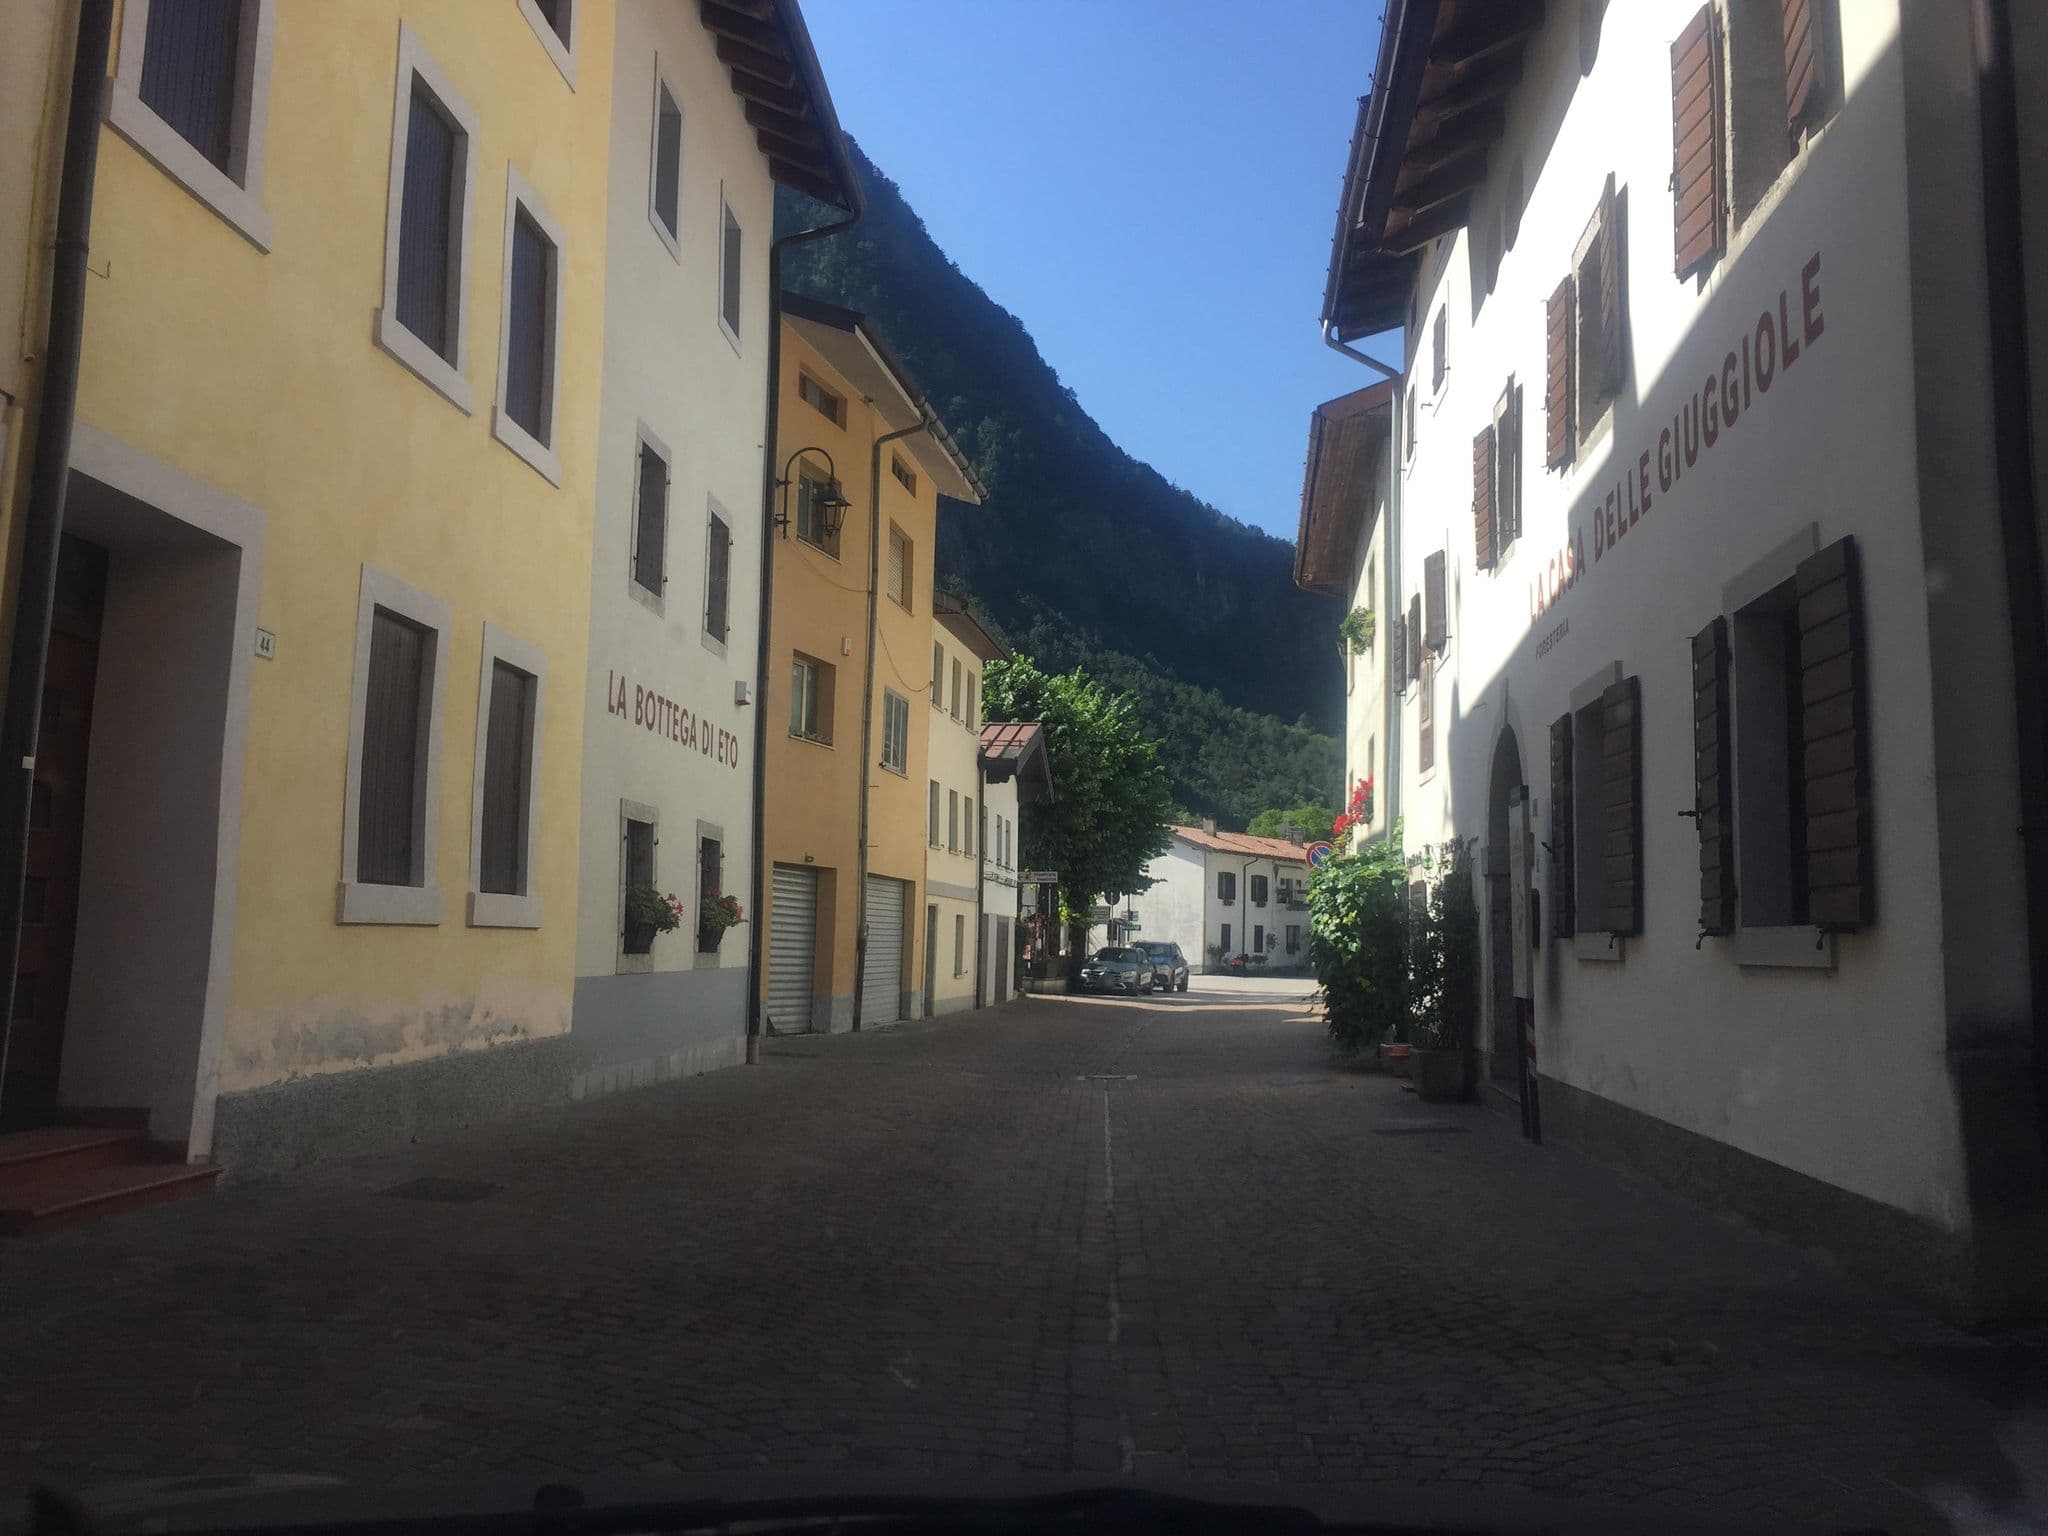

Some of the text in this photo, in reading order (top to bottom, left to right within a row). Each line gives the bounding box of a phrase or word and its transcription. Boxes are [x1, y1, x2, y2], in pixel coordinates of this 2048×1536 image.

[1529, 251, 1825, 627] LA CASA DELLE GIUGGIOLE
[608, 669, 738, 769] LA BOTTEGA DI ETO
